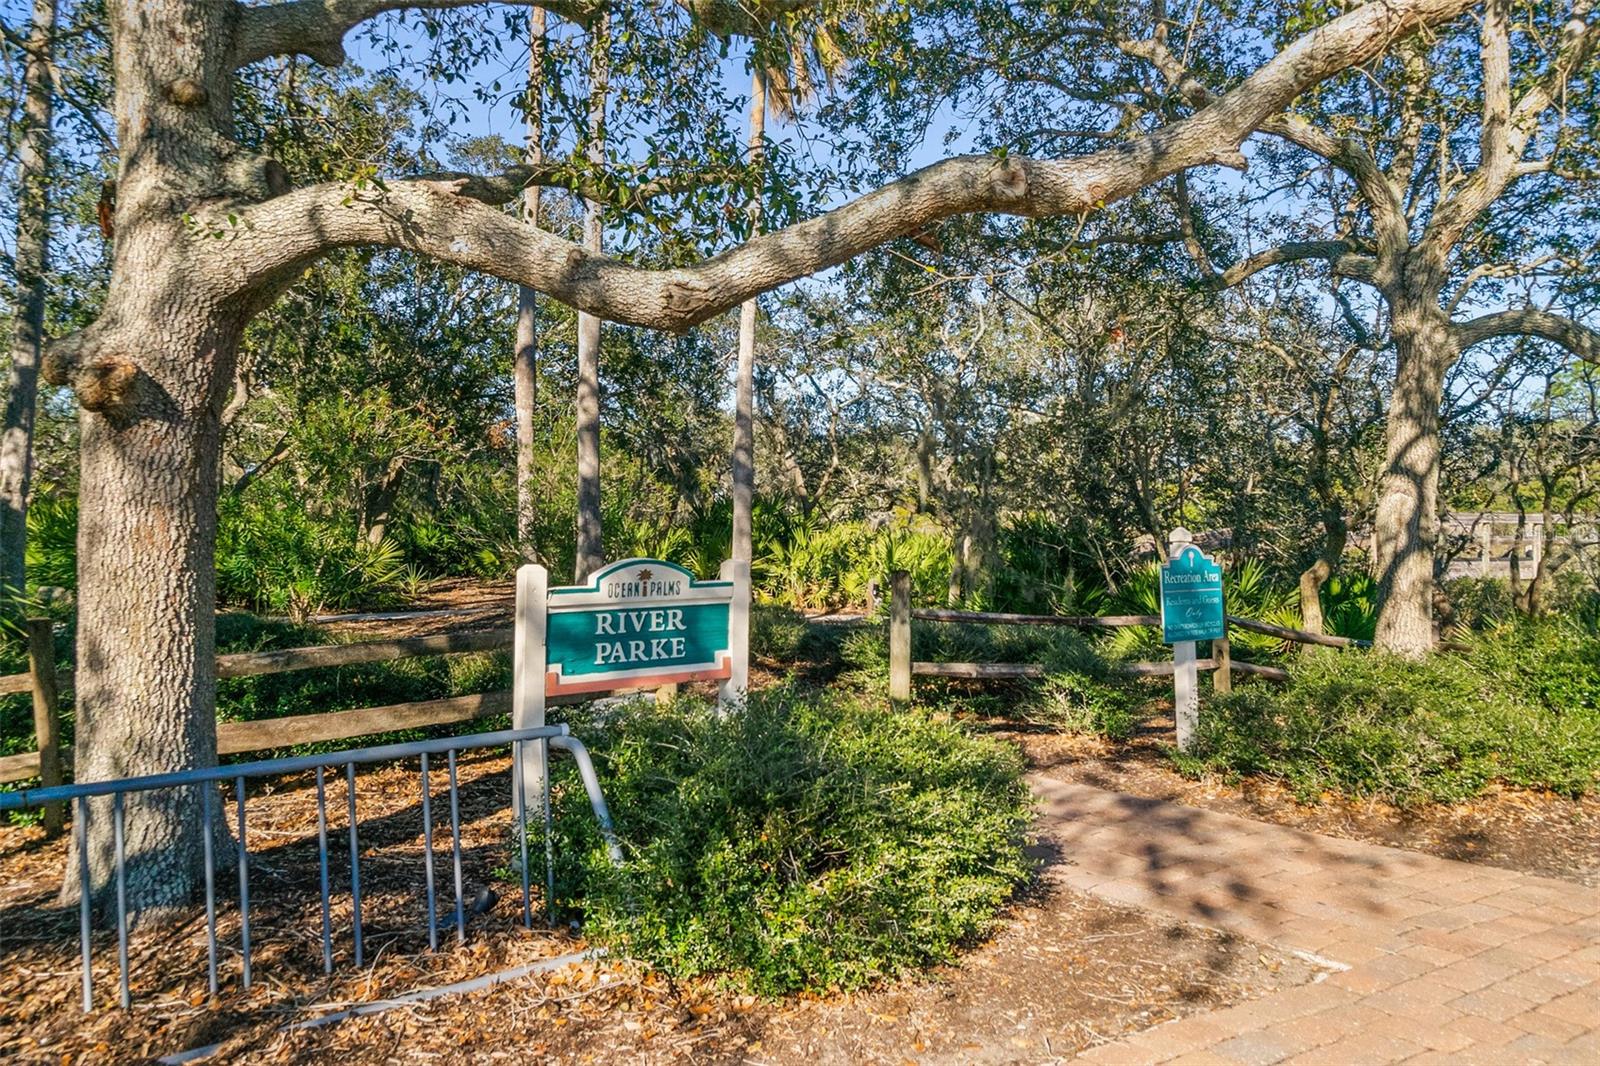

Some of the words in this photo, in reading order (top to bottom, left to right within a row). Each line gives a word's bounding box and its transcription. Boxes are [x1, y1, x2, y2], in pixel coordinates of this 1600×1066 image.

[1164, 570, 1201, 584] Recreation
[1203, 569, 1219, 583] Area
[608, 583, 640, 599] OCEAN
[650, 580, 681, 596] PALMS
[595, 609, 687, 635] RIVER
[594, 637, 686, 665] PARKE
